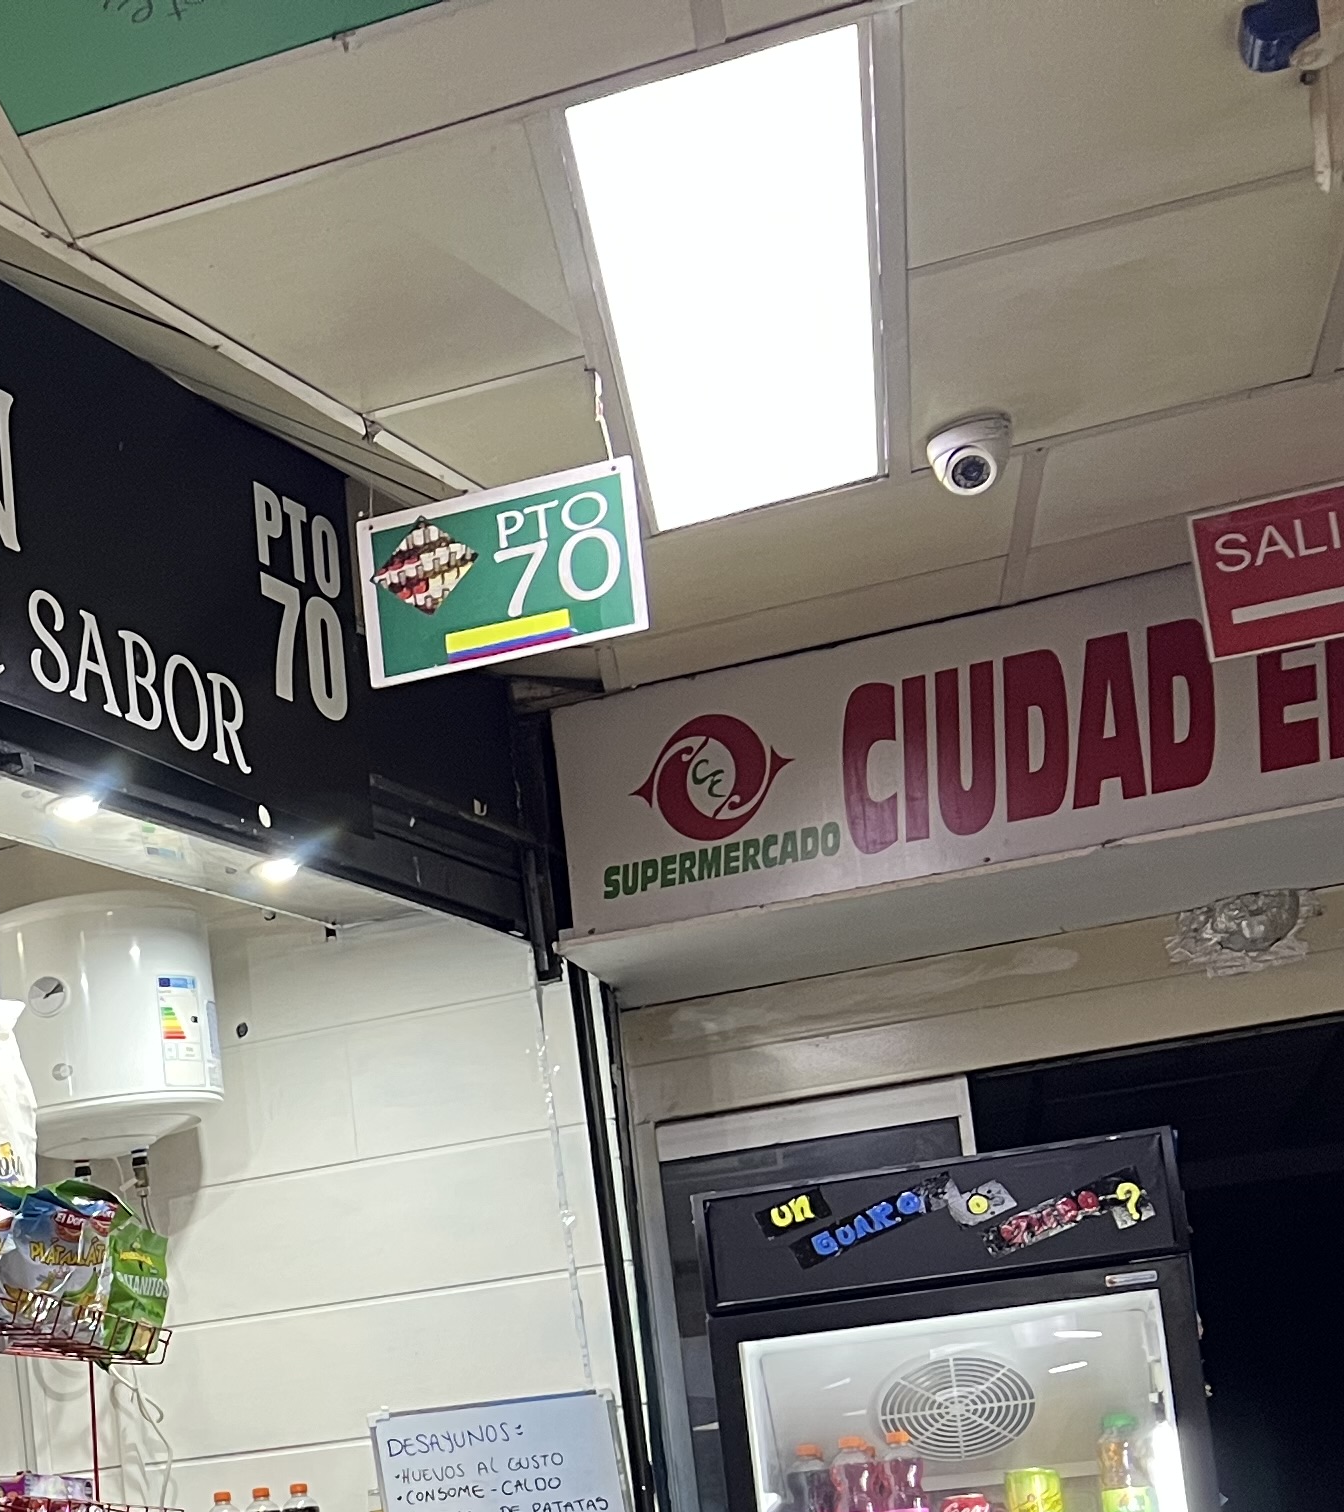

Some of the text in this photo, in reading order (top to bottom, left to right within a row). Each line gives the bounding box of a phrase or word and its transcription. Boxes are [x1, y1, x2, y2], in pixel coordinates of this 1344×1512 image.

[252, 480, 341, 600] PTO
[497, 490, 609, 548] PTO
[1214, 511, 1342, 573] SALI
[493, 526, 623, 619] 70
[27, 589, 253, 775] SABOR
[260, 572, 350, 722] 70
[842, 617, 1344, 857] CIUDAD E
[603, 821, 841, 900] SUPERMERCADO
[402, 1463, 466, 1484] HUEVOS
[508, 1452, 564, 1472] GUSTO
[406, 1484, 486, 1505] CONSOME
